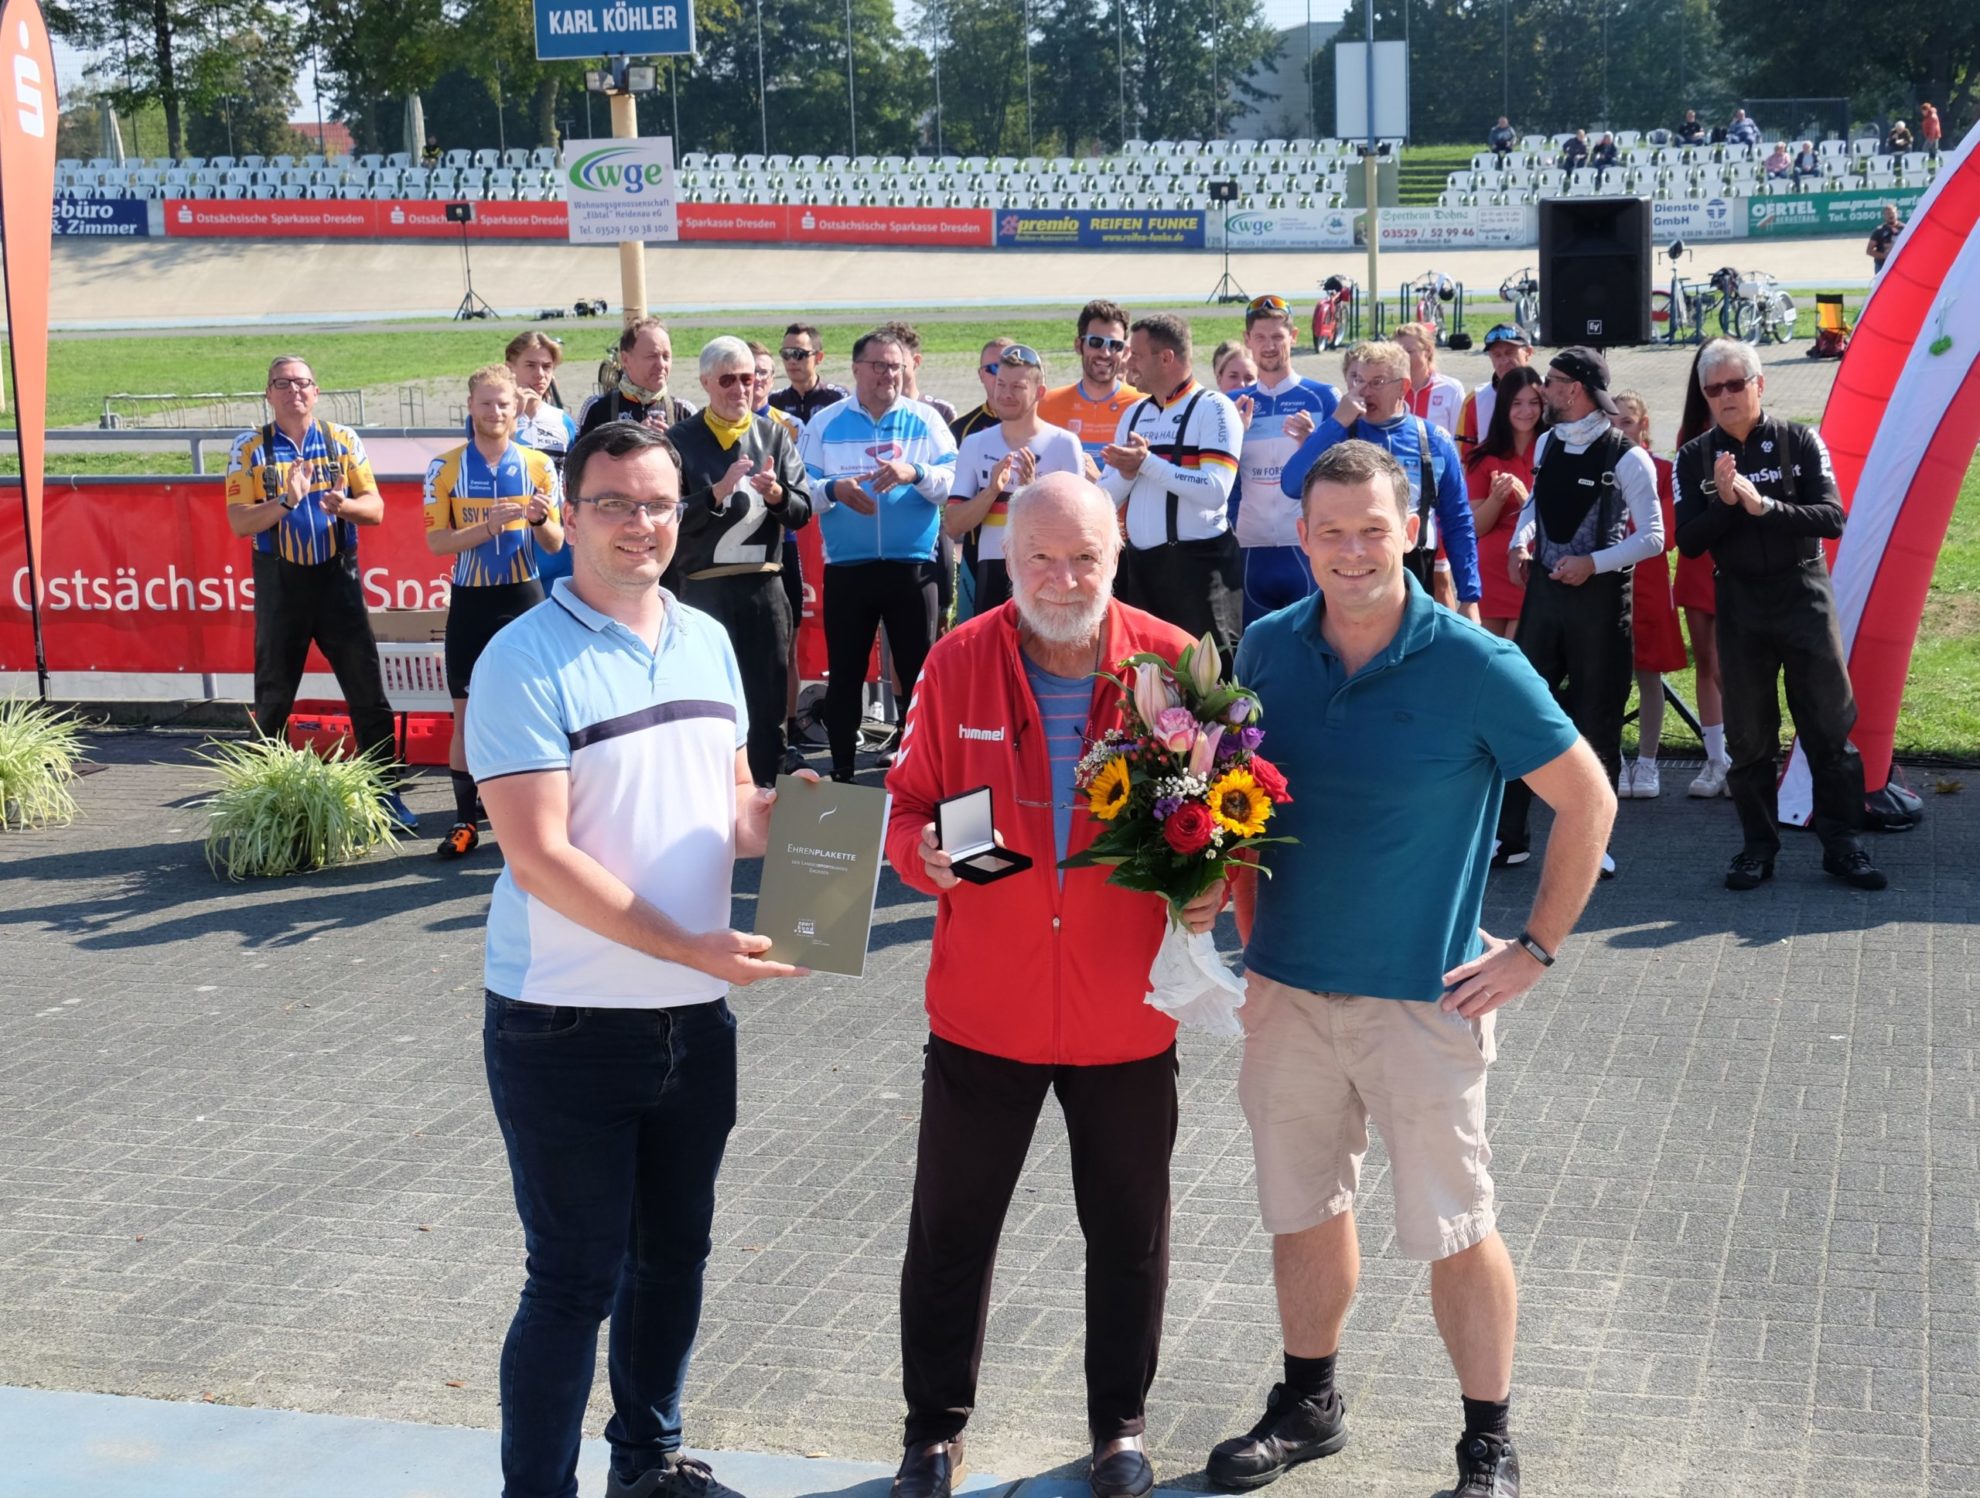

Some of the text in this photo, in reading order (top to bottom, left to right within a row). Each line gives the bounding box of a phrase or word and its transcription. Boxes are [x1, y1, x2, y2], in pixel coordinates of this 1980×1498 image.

[549, 1, 677, 35] KARL KÖHLER
[595, 164, 662, 193] wge
[1654, 204, 1700, 212] Dienste
[1752, 201, 1816, 217] OERTEL
[197, 213, 364, 225] Ostsächsische Sparkasse Dresden
[480, 214, 529, 226] Sparkasse
[686, 217, 734, 228] Sparkasse
[736, 218, 776, 229] Dresden
[820, 218, 980, 233] Ostsächsische Sparkasse Dresden
[1016, 216, 1079, 233] premio
[1090, 218, 1198, 230] REIFEN FUNKE
[1653, 216, 1690, 226] GmbH
[66, 220, 137, 234] Zimmer
[654, 224, 668, 232] 100
[1382, 228, 1418, 238] 03529
[1431, 228, 1443, 238] 52
[1446, 228, 1459, 237] 99
[1462, 228, 1475, 236] 46
[1174, 472, 1208, 485] vermarc
[462, 507, 480, 523] SSV
[714, 475, 768, 563] 2
[959, 724, 1004, 741] hummel
